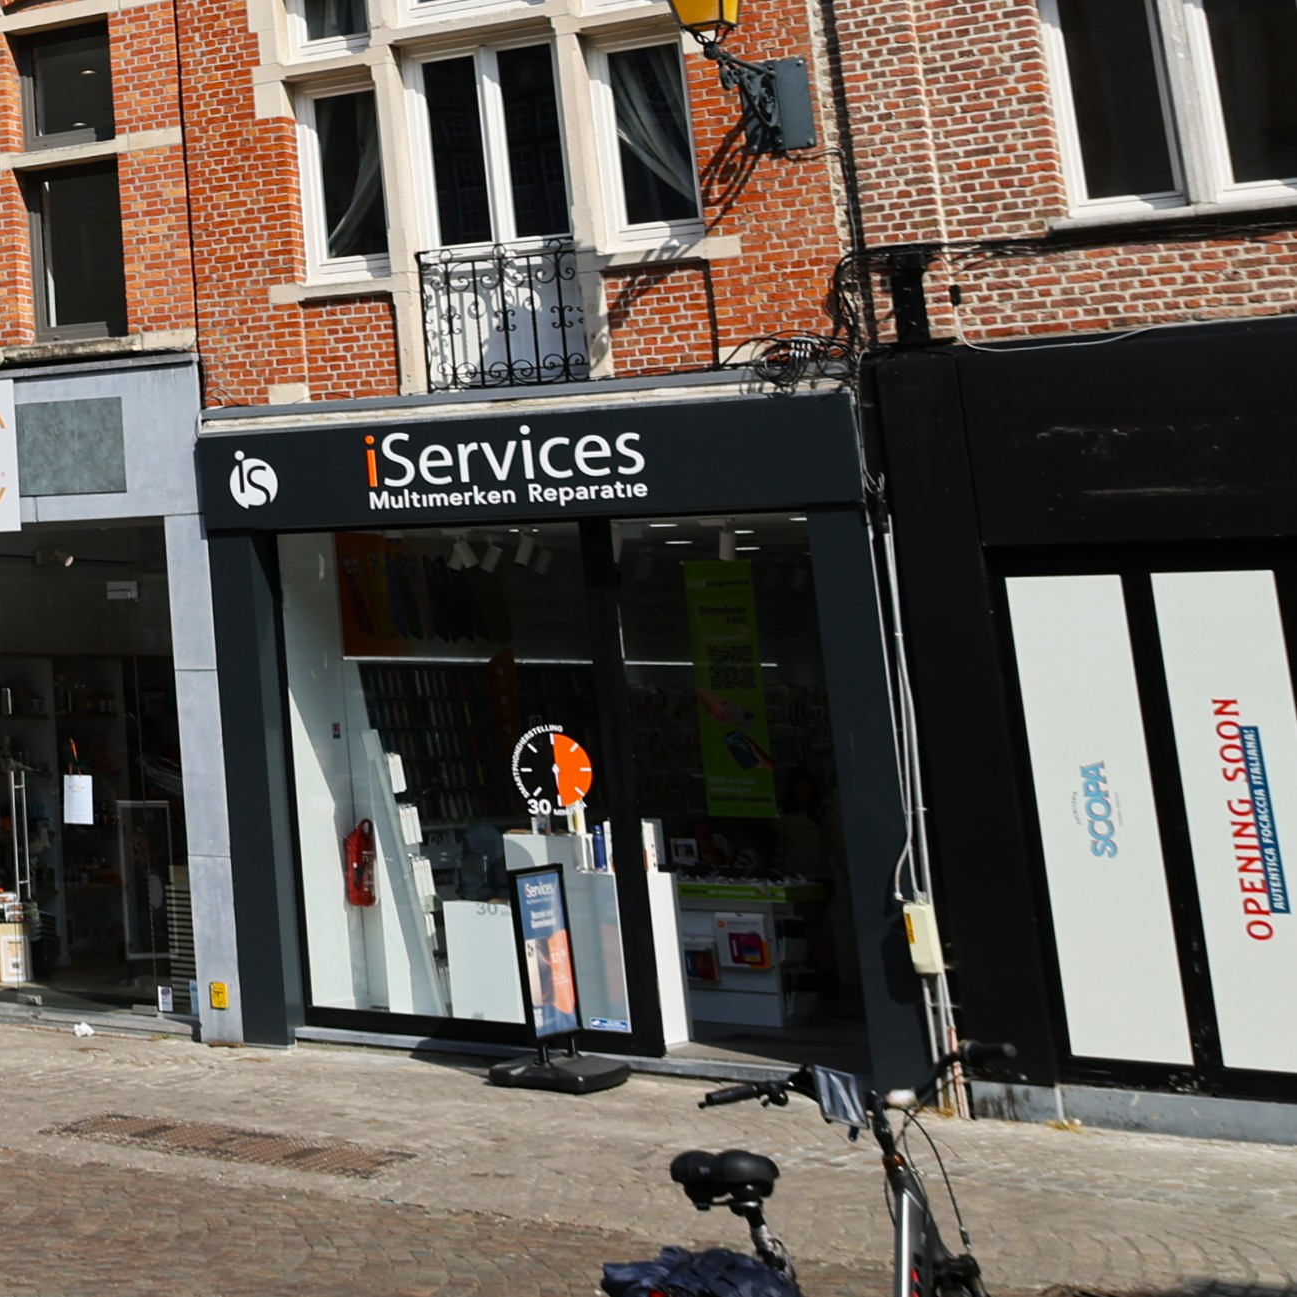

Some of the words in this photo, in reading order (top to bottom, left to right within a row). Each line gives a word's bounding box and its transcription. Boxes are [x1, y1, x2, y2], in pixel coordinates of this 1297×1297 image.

[364, 424, 646, 489] iServices
[369, 488, 516, 510] Multimerken
[528, 480, 648, 506] Reparatie
[1211, 698, 1250, 783] SOON
[1243, 727, 1264, 786] ITALIANA!
[527, 798, 552, 816] 30
[1079, 760, 1118, 858] SCOPA
[1254, 788, 1274, 845] FOCACCIA
[1227, 798, 1274, 941] OPENING
[1265, 847, 1287, 911] AUTENTICA
